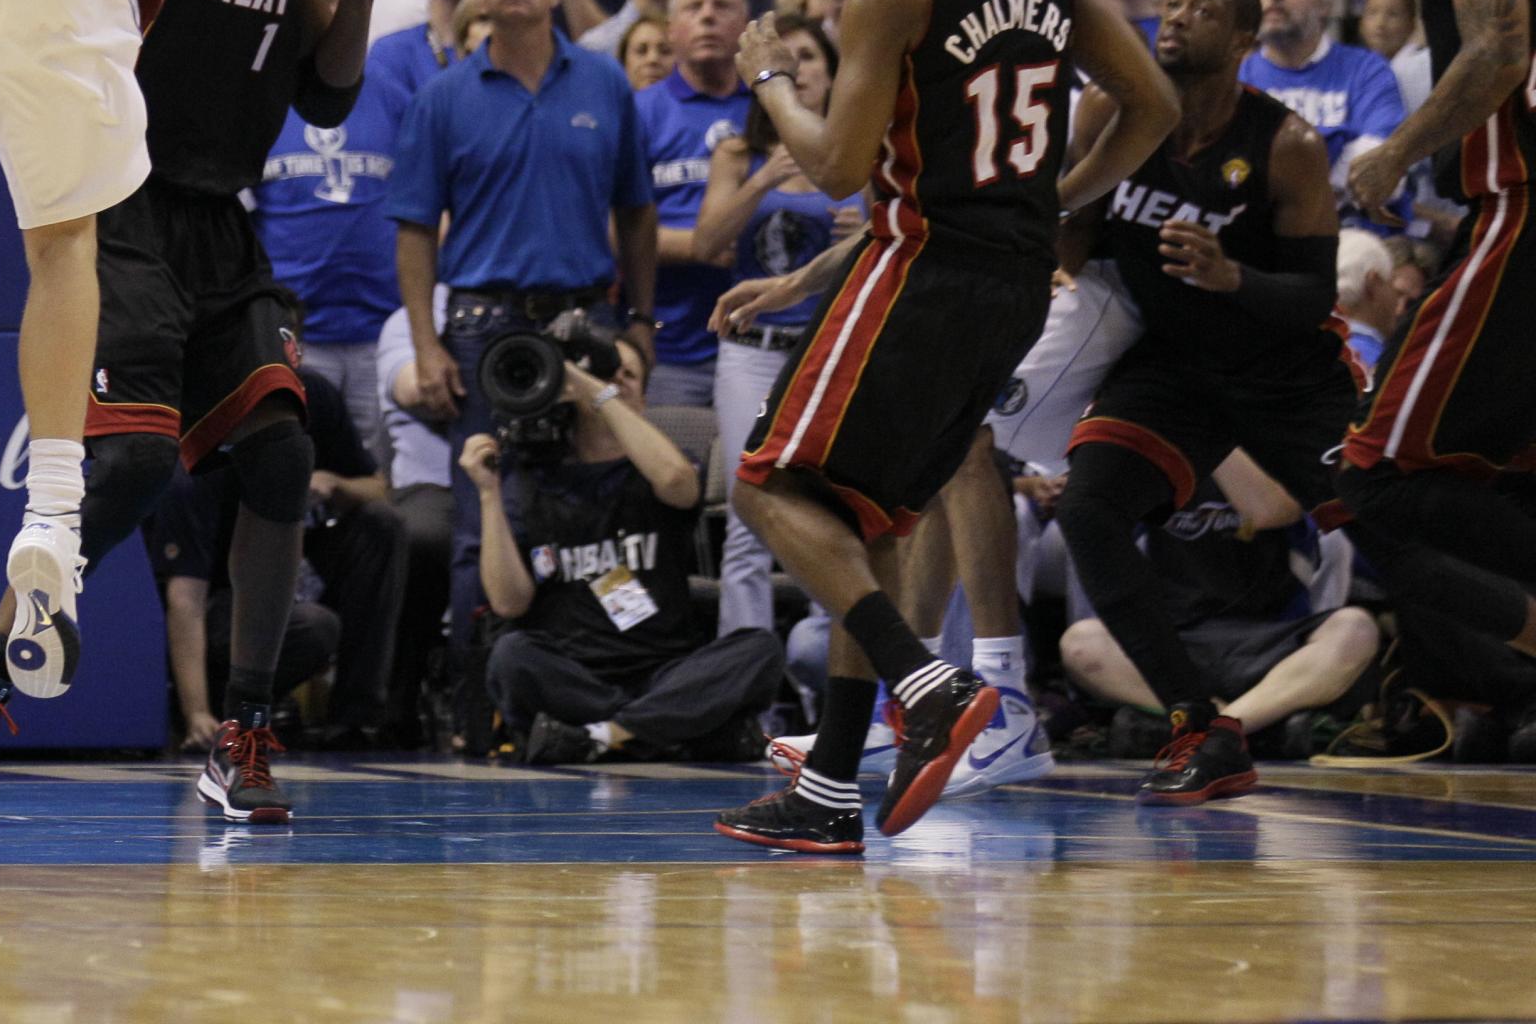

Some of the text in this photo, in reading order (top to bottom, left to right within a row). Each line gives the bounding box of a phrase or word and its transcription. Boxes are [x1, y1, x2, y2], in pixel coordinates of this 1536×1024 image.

[250, 22, 280, 72] 1
[965, 58, 1062, 189] 15
[1105, 179, 1247, 235] HEAT
